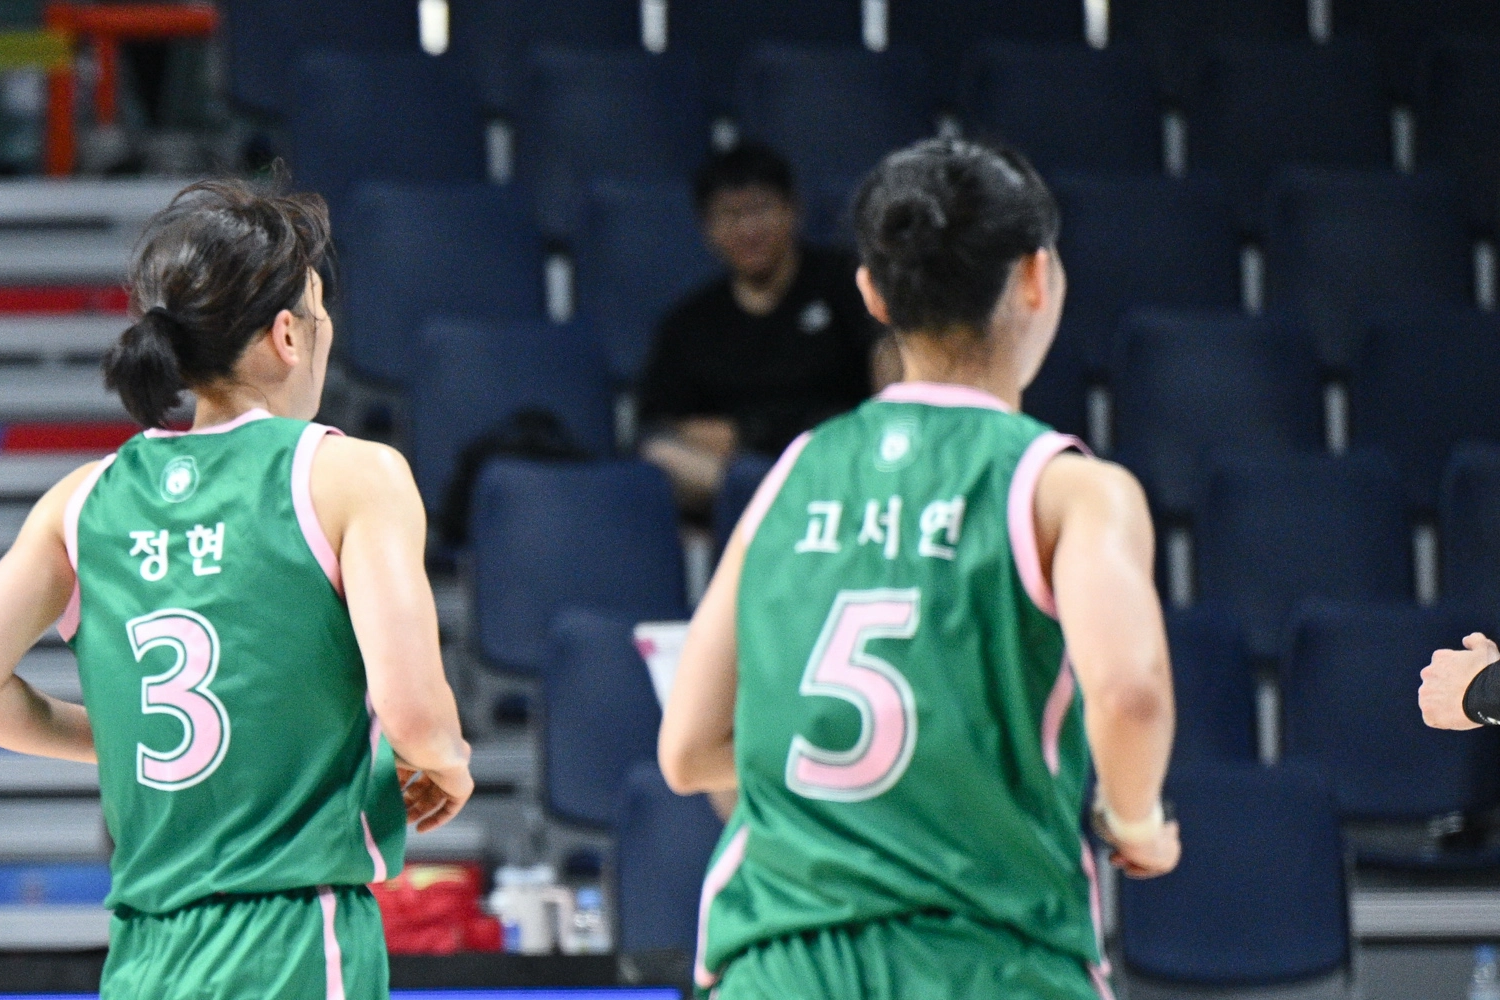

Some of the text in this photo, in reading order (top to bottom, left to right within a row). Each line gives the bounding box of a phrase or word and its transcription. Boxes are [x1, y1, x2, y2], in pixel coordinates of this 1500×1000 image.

[128, 522, 226, 582] 정현
[794, 495, 966, 561] 고서연
[125, 607, 231, 791] 3
[785, 587, 921, 803] 5
